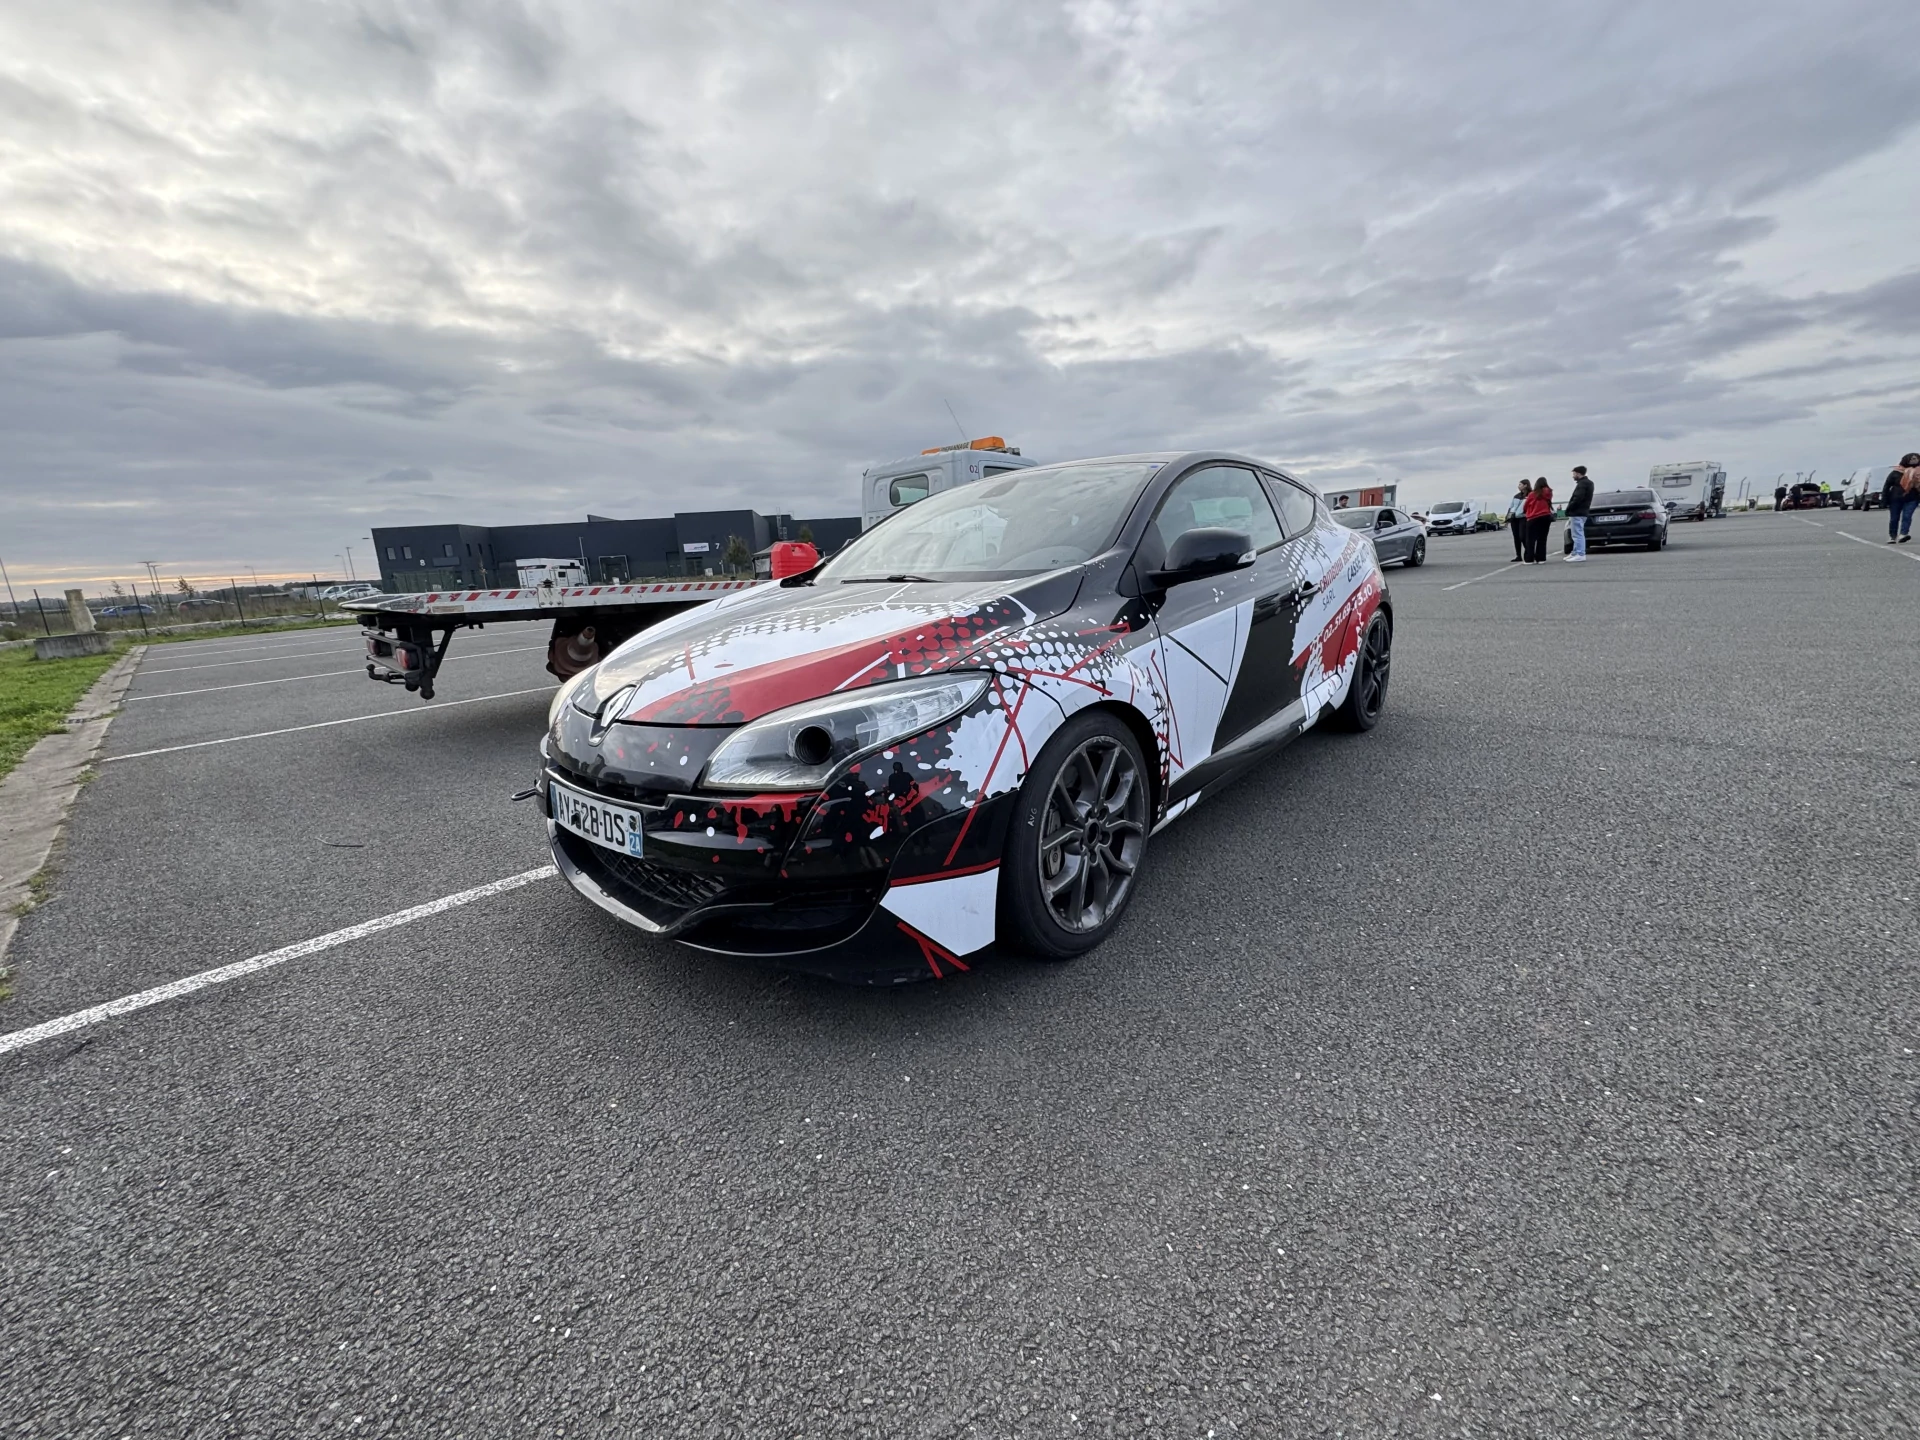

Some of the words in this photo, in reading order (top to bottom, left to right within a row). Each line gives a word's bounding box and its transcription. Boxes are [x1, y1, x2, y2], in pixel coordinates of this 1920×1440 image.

[969, 464, 979, 473] 02
[715, 542, 720, 550] 7
[419, 559, 426, 567] 8
[558, 791, 626, 847] AY-528-DS
[629, 834, 641, 853] 2A
